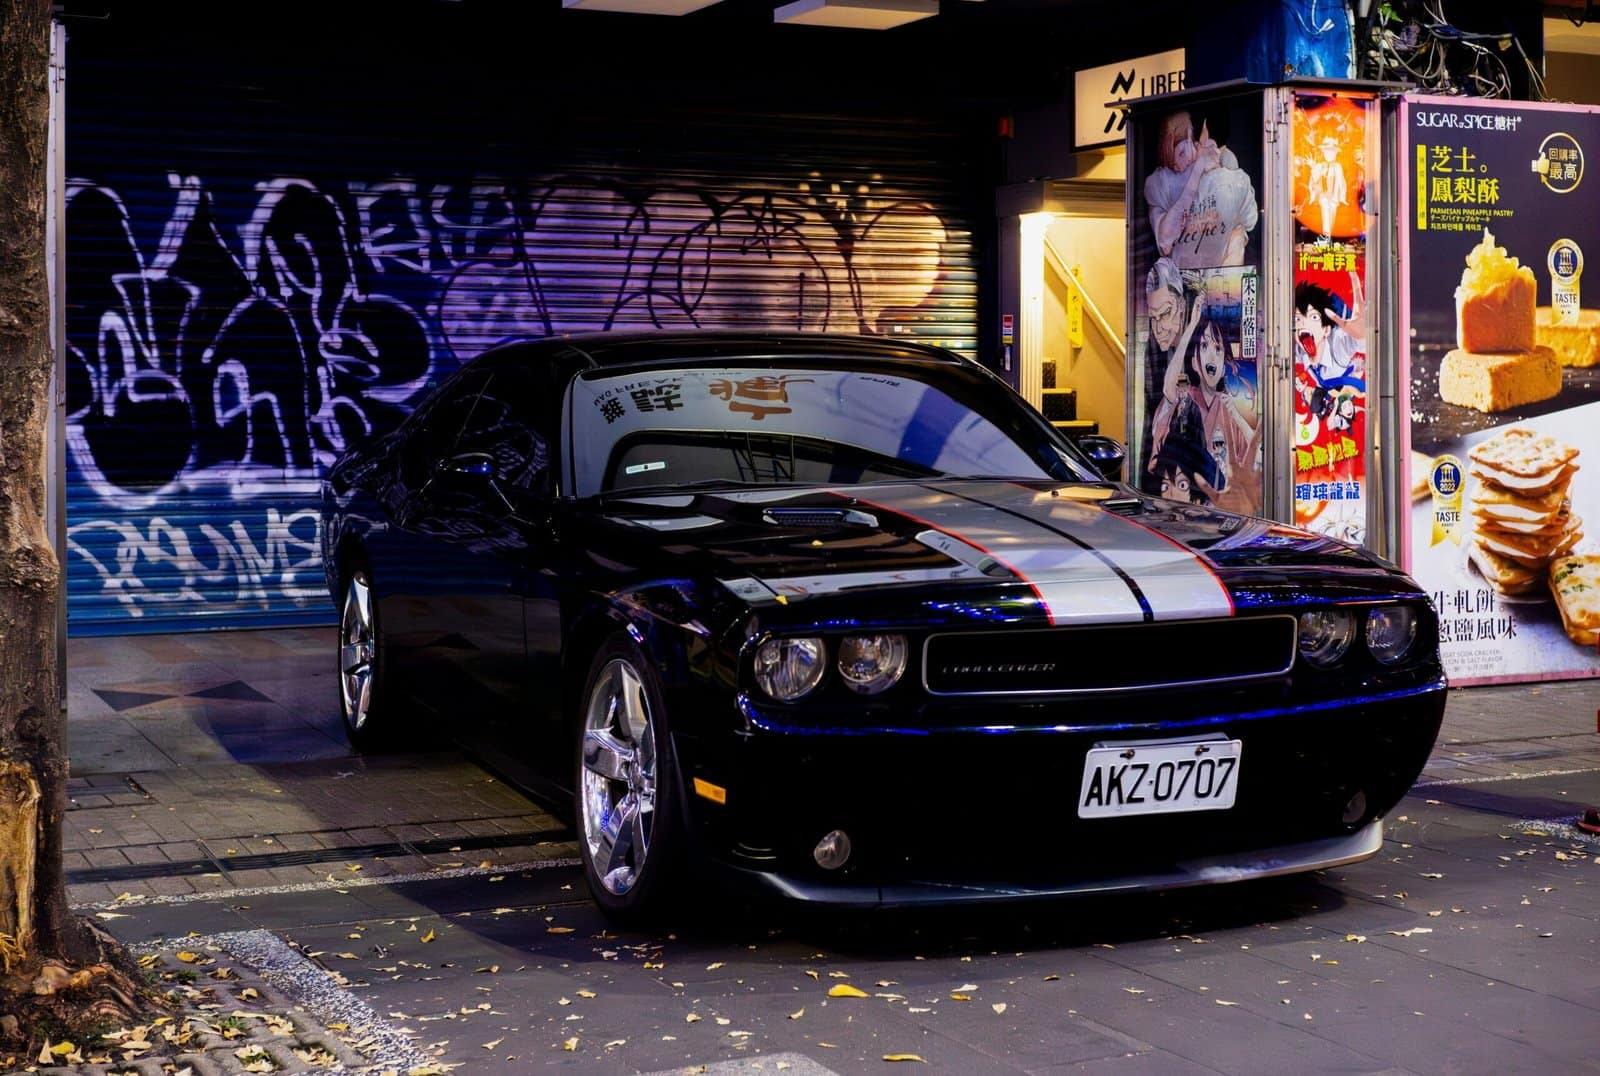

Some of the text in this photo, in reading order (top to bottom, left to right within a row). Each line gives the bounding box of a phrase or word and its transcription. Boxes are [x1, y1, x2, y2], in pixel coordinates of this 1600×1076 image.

[1416, 111, 1459, 128] SUGAR
[1464, 113, 1494, 129] SPICE
[1549, 163, 1577, 180] 最高
[1430, 176, 1500, 204] 鳳梨酥
[1555, 293, 1577, 303] TASTE
[1435, 511, 1460, 522] TASTE
